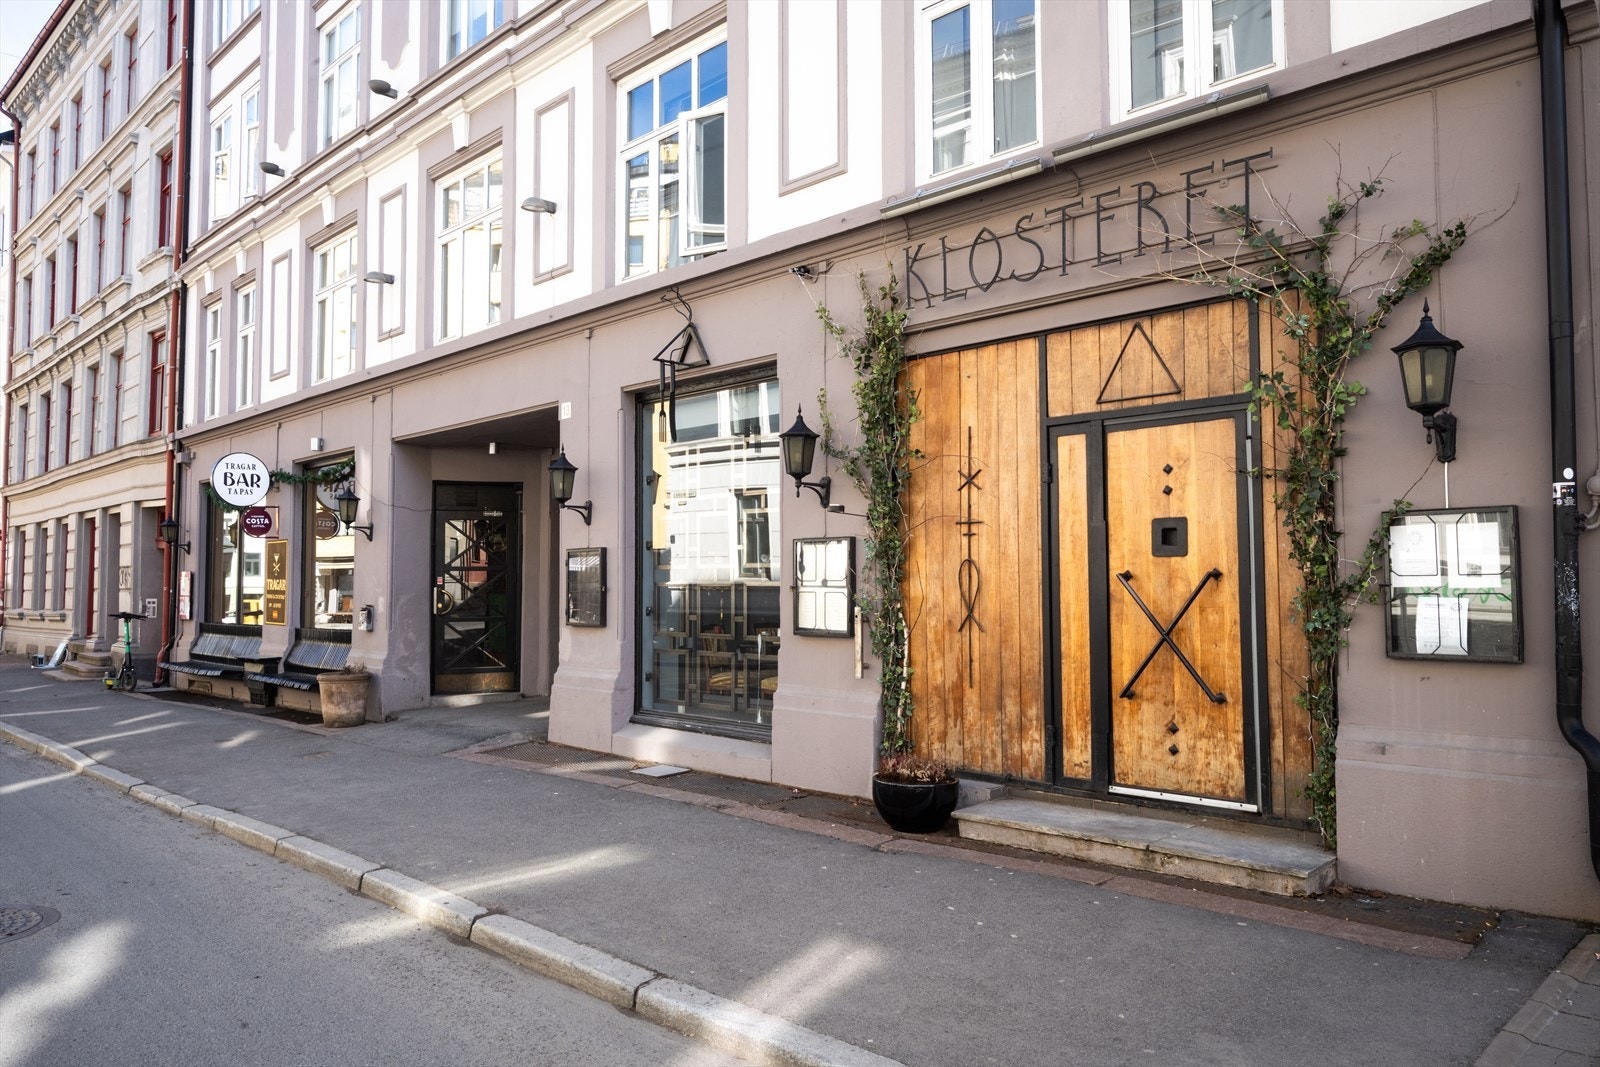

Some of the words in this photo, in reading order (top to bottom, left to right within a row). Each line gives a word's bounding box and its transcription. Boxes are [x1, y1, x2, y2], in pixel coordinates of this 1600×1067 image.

[903, 146, 1273, 310] KLOSTERET
[563, 404, 570, 417] 13
[223, 472, 261, 488] BAR
[266, 579, 287, 591] TRAGAR
